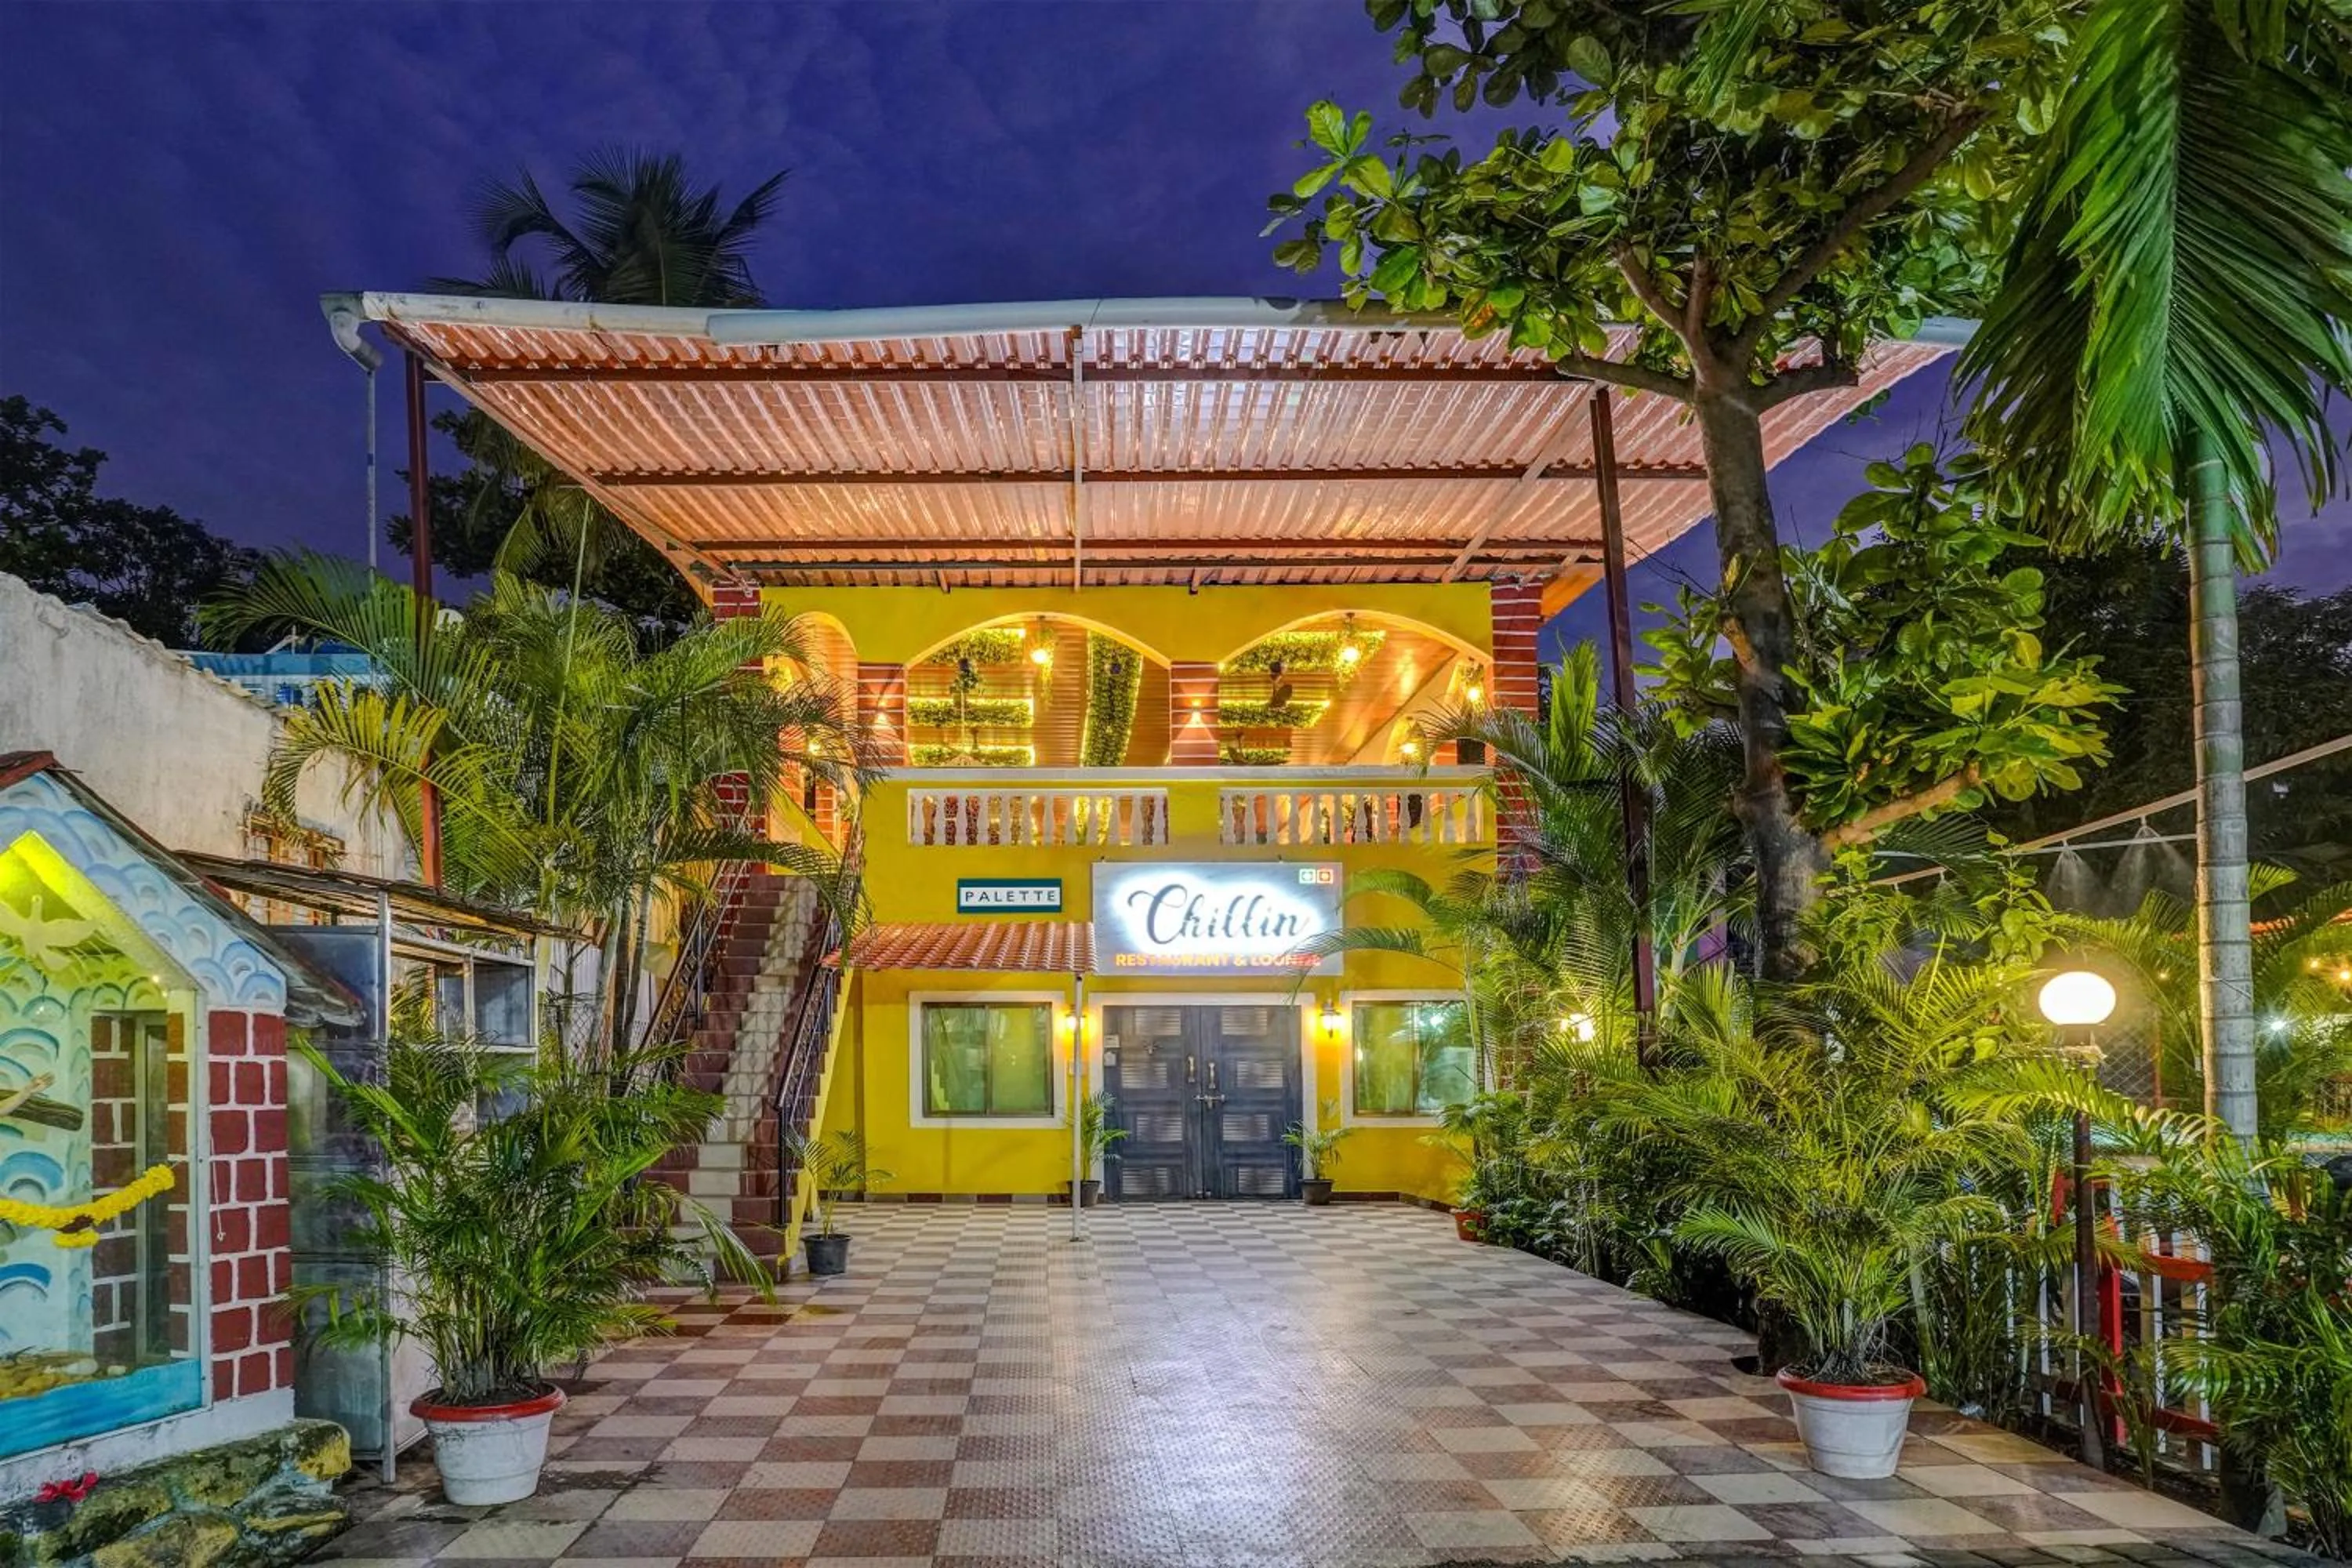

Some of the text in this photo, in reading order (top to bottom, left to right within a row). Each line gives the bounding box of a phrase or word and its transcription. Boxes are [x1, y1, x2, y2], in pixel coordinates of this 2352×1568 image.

[965, 891, 1056, 902] PALETTE
[1127, 884, 1309, 944] Chillin
[1116, 953, 1229, 966] RESTAURANT
[1234, 953, 1247, 966] &
